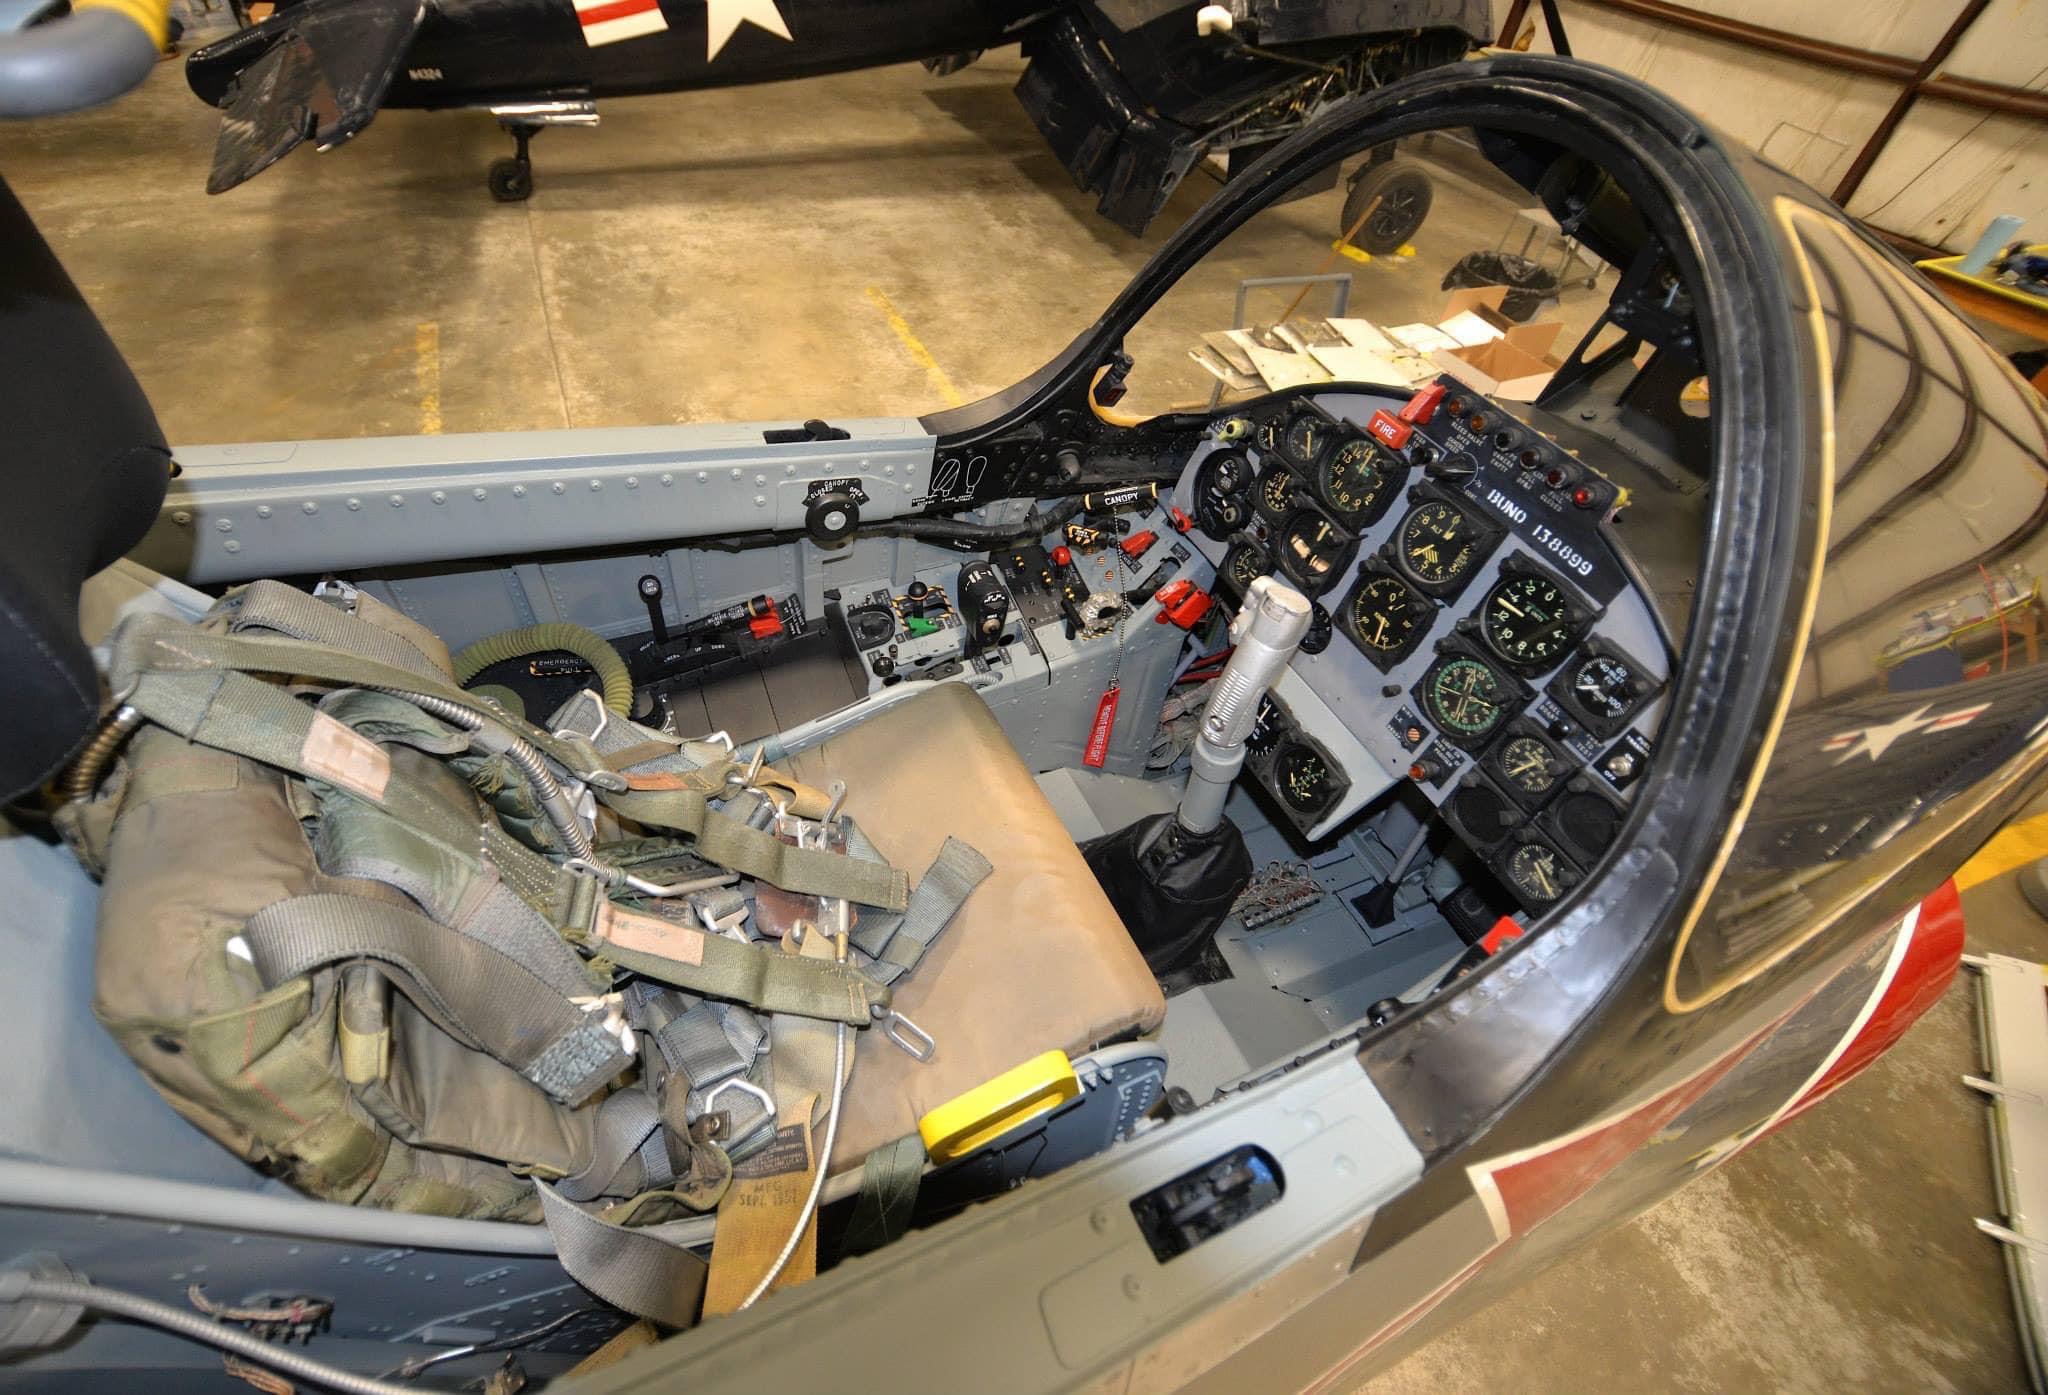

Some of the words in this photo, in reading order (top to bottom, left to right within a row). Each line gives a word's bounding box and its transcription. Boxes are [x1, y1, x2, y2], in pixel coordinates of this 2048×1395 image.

[1374, 419, 1397, 440] FIRE
[1343, 453, 1352, 464] 13
[1335, 465, 1345, 475] 12
[1376, 480, 1384, 489] 7
[1104, 492, 1139, 506] CANOPY
[1341, 493, 1350, 503] 10
[1422, 515, 1431, 525] 8
[1438, 511, 1446, 519] 9
[1431, 524, 1443, 535] ALT
[1487, 489, 1527, 524] BUNO
[1532, 524, 1593, 576] 138899
[1435, 566, 1444, 575] 4
[1526, 585, 1536, 595] 2
[1545, 591, 1554, 601] 0
[1500, 610, 1510, 622] 12
[1501, 628, 1513, 640] 10
[1518, 641, 1527, 651] 8
[1537, 642, 1545, 651] 6
[538, 658, 585, 667] EMERGENCY
[1600, 662, 1610, 673] 40
[1615, 666, 1627, 678] 60
[1607, 696, 1622, 710] 100
[1576, 743, 1593, 759] TEST
[1603, 770, 1617, 782] OFF
